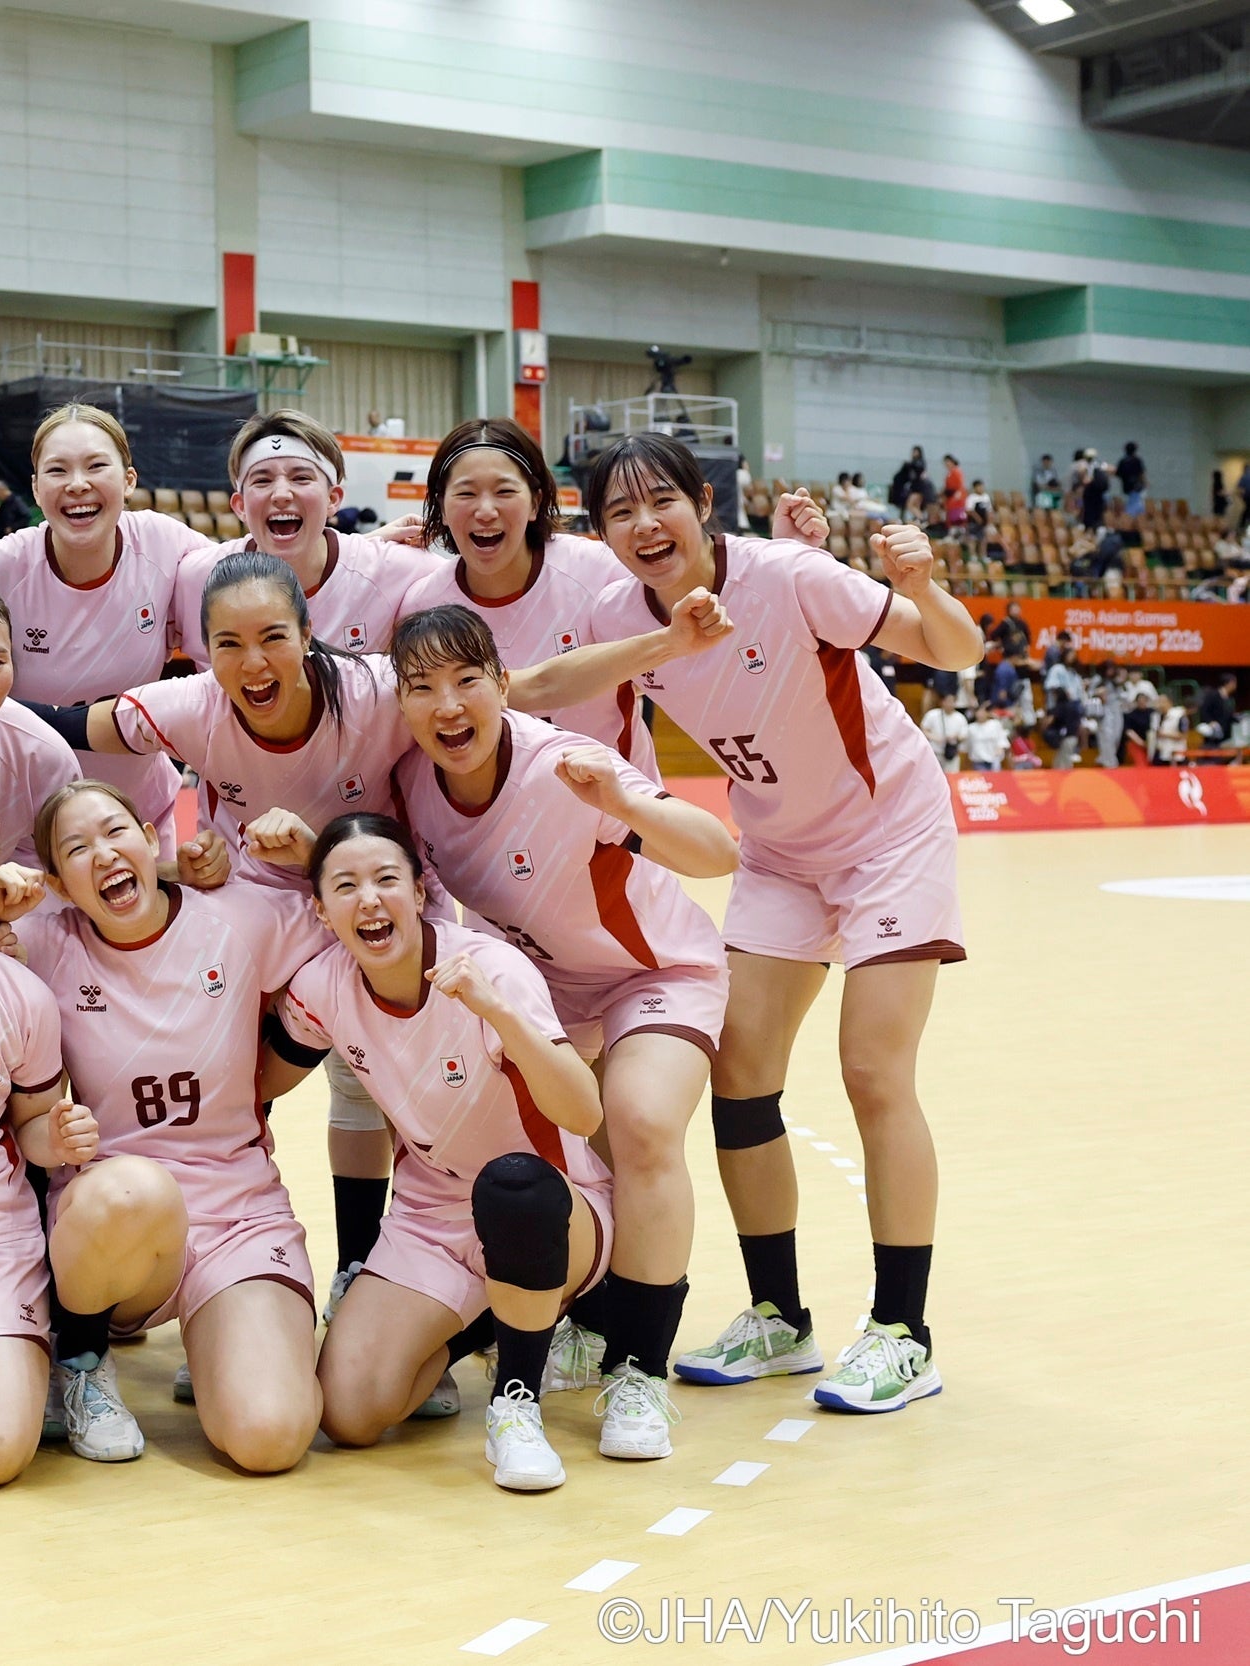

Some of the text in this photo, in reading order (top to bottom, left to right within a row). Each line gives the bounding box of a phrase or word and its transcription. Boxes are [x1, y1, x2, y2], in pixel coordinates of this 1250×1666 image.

[1097, 610, 1131, 627] Asian
[1133, 611, 1178, 627] Games
[141, 620, 154, 630] JAPAN
[348, 640, 364, 648] JAPAN
[1036, 626, 1204, 657] Aihi-Nagoya 2026
[23, 643, 50, 654] hummel
[748, 661, 764, 670] JAPAN
[708, 733, 779, 784] 65
[345, 790, 363, 800] JAPAN
[514, 868, 532, 876] JAPAN
[877, 930, 902, 939] hummel
[208, 983, 223, 993] JAPAN
[76, 1003, 107, 1012] hummel
[447, 1074, 464, 1082] JAPAN
[131, 1070, 201, 1129] 89
